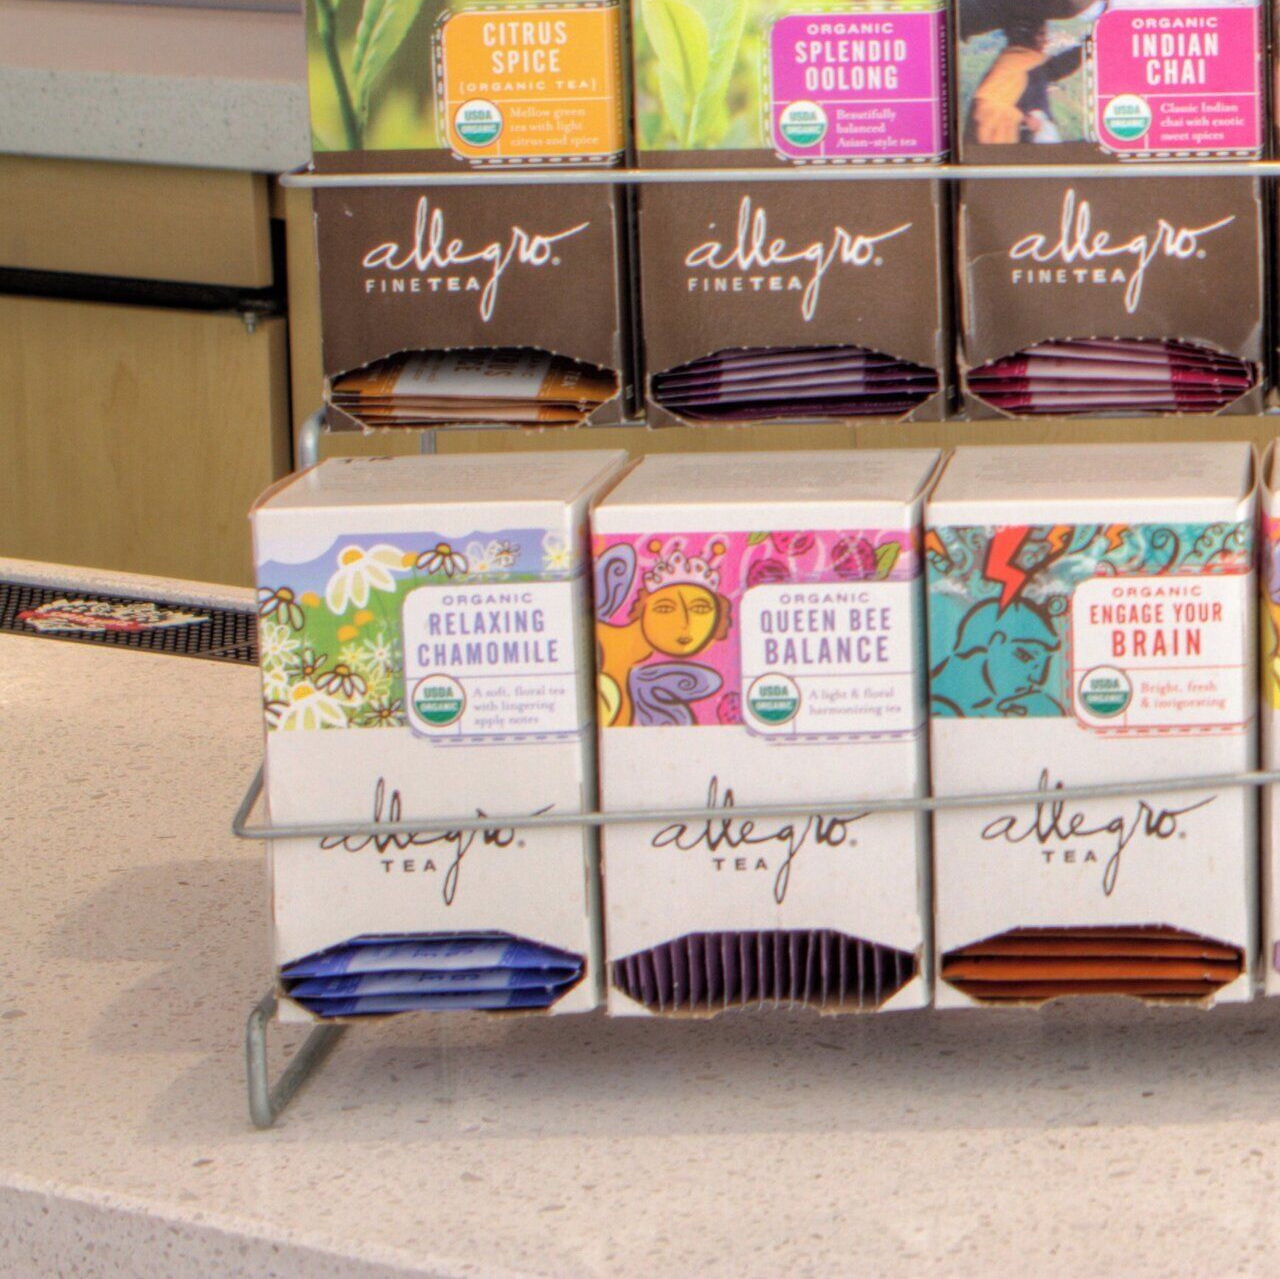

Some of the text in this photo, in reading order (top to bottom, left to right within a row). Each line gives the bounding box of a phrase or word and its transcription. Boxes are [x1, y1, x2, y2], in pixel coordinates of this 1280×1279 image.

[482, 20, 568, 48] CITRUS
[806, 22, 894, 36] ORGANIC
[1131, 16, 1219, 30] ORGANIC
[794, 39, 907, 64] SPLENDID
[1132, 32, 1220, 59] INDIAN
[490, 49, 561, 75] SPICE
[1145, 58, 1207, 86] CHAI
[805, 64, 898, 92] OOLONG
[442, 592, 533, 606] ORGANIC
[779, 591, 870, 605] ORGANIC
[1112, 585, 1202, 598] ORGANIC
[428, 609, 546, 636] RELAXING
[760, 607, 892, 634] QUEEN BEE
[1089, 602, 1223, 625] ENGAGE YOUR
[417, 638, 559, 668] CHAMOMILE
[764, 635, 890, 666] BALANCE
[1111, 628, 1202, 658] BRAIN
[381, 859, 438, 874] TEA
[713, 857, 769, 872] TEA
[1041, 850, 1100, 864] TEA
